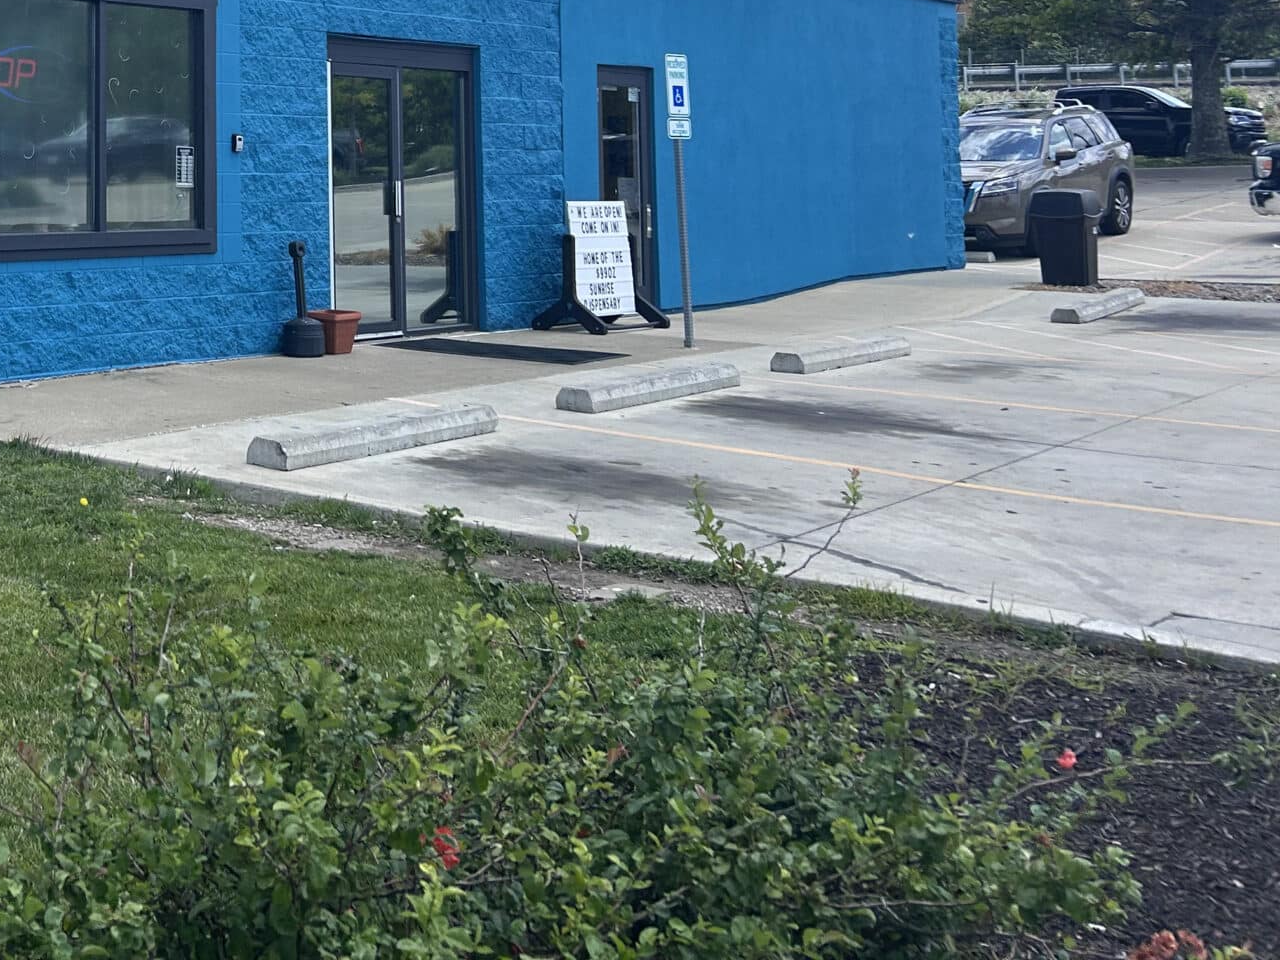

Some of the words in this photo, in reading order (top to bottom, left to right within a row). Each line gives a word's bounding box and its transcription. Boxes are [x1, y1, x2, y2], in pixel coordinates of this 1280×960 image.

[576, 206, 587, 218] WE
[591, 206, 603, 218] ARE
[581, 221, 597, 234] COME
[600, 221, 609, 233] ON
[583, 251, 599, 265] HOME
[600, 251, 608, 264] OF
[611, 250, 623, 263] THE
[589, 282, 614, 296] SUNRISE
